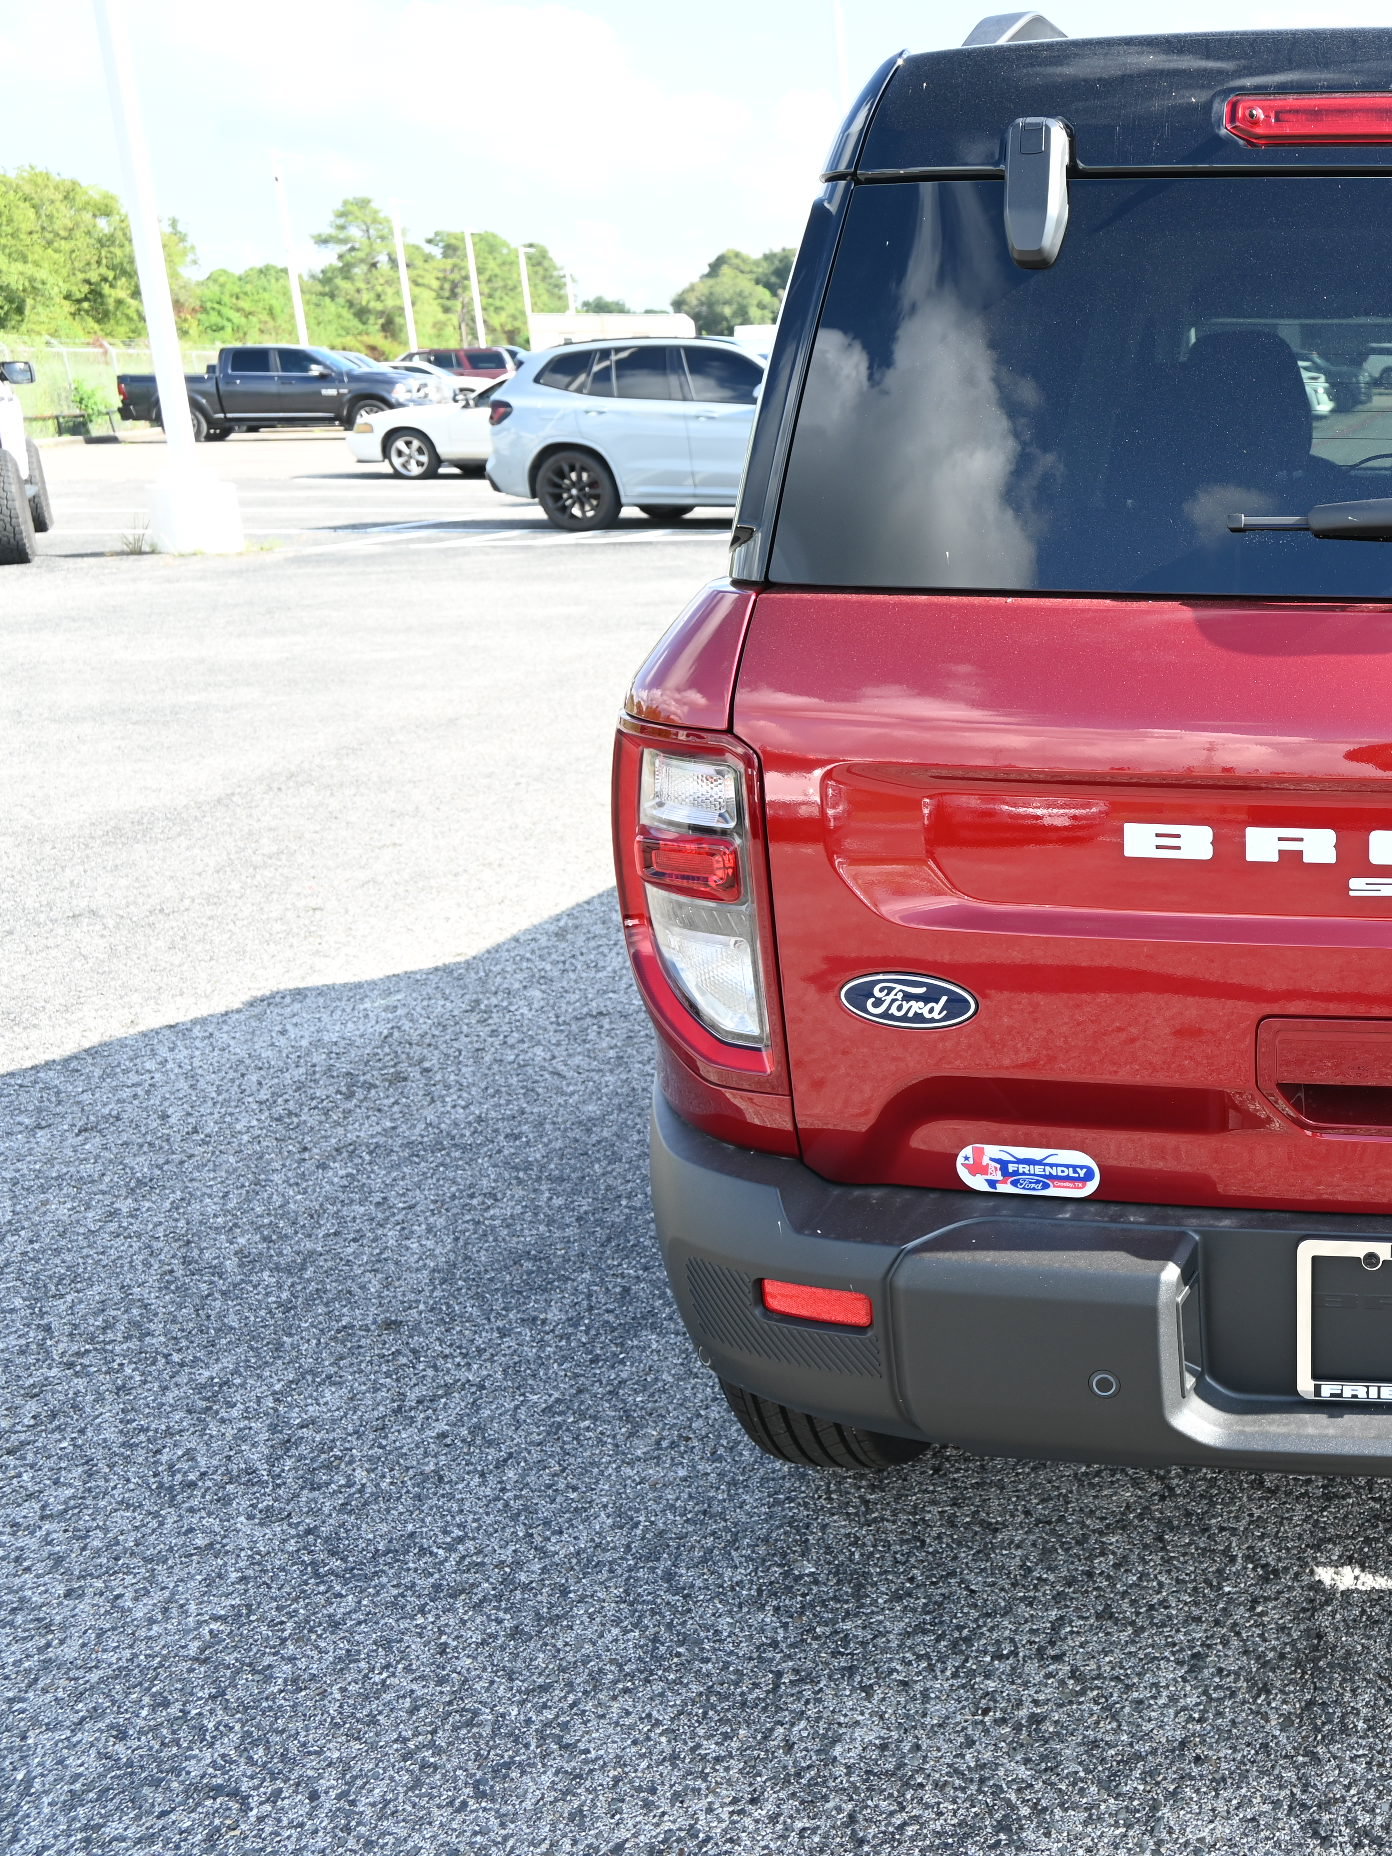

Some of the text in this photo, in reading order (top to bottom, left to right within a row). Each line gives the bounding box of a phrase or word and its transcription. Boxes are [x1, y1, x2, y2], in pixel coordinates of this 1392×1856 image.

[866, 982, 948, 1020] Ford
[1007, 1163, 1088, 1178] FRIENDLY
[1017, 1178, 1043, 1190] Ford
